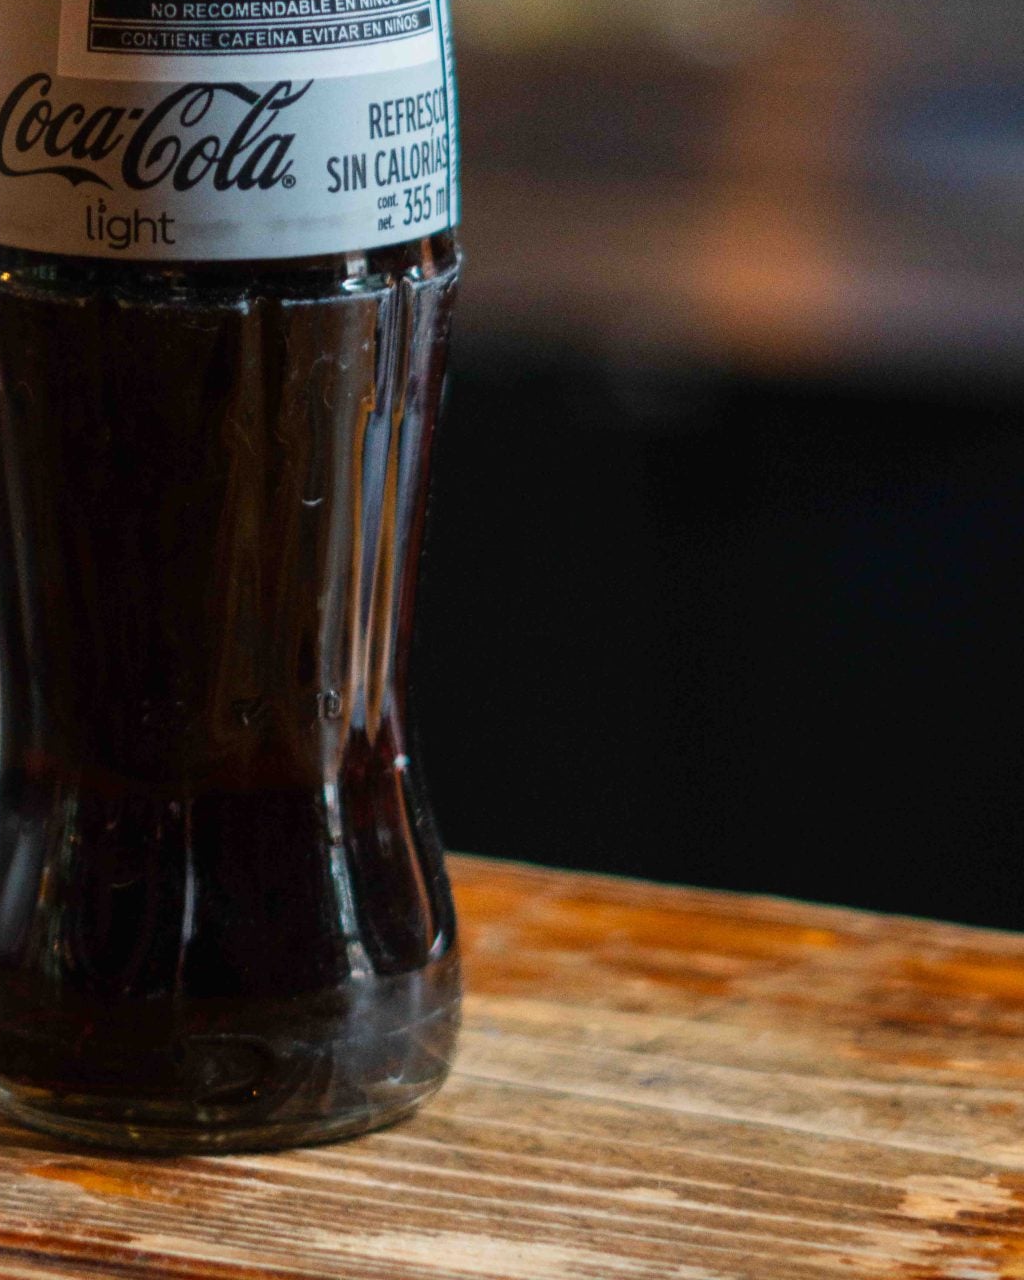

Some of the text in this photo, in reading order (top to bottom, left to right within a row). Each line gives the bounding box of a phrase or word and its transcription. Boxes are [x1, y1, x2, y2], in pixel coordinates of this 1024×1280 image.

[121, 13, 419, 48] CONTIENE CAFEÍNA EVITAR EN NIÑOS
[151, 3, 177, 18] NO
[369, 85, 447, 140] REFRESCO
[326, 153, 367, 194] SIN
[86, 198, 175, 250] light
[402, 183, 433, 227] 355
